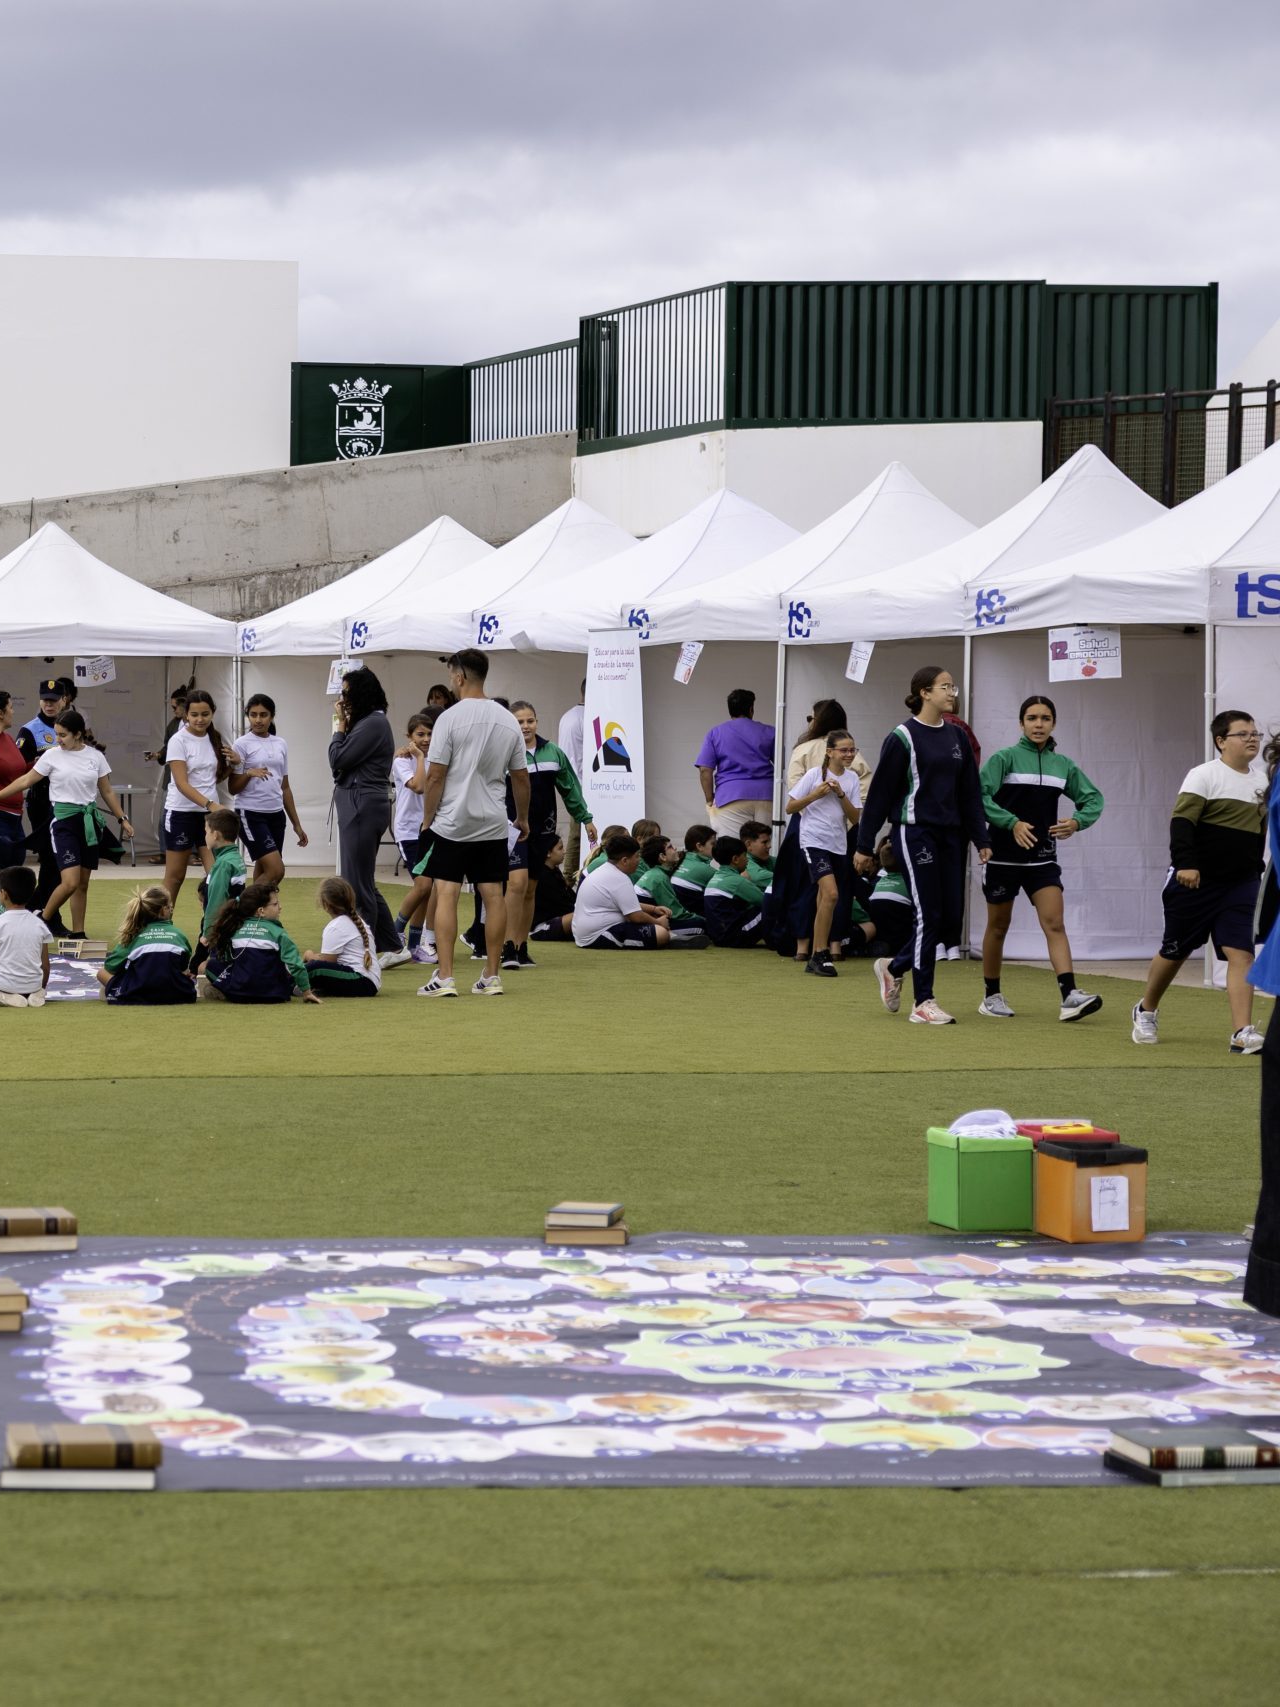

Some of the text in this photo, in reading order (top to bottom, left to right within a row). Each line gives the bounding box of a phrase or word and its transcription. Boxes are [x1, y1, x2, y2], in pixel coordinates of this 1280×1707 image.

[1050, 640, 1069, 660] 12
[1079, 638, 1110, 650] Salud
[1069, 647, 1120, 660] emocional
[590, 778, 610, 791] Lorena
